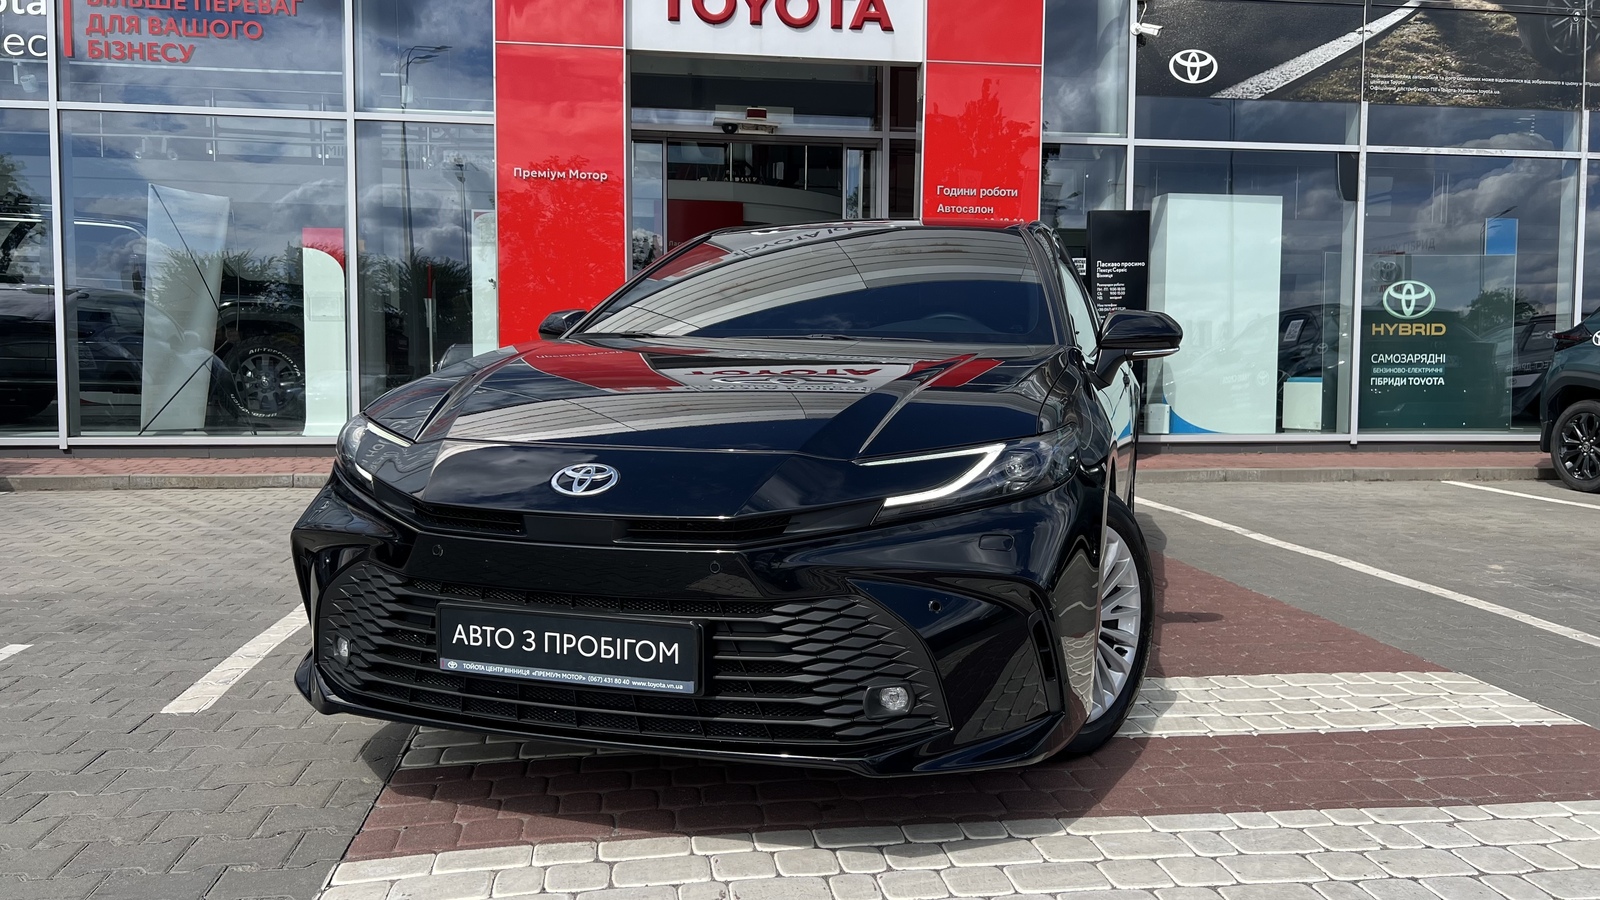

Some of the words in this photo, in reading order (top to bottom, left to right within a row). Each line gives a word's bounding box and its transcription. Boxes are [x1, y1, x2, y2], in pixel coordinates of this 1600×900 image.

[86, 13, 142, 36] ДЛЯ
[148, 16, 265, 40] ВАШОГО
[87, 39, 196, 63] БІЗНЕСУ
[513, 167, 566, 181] Преміум
[569, 169, 608, 182] Мотор
[936, 185, 977, 197] Години
[980, 186, 1018, 198] роботи
[936, 203, 994, 214] Автосалон
[1121, 260, 1145, 268] просимо
[1371, 323, 1447, 336] HYBRID
[1371, 353, 1446, 364] САМОЗАРЯДНІ
[1370, 377, 1406, 386] ГІБРИДИ
[1408, 377, 1445, 386] TOYOTA
[452, 623, 515, 650] АВТО
[521, 629, 536, 651] З
[544, 631, 679, 665] ПРОБІГОМ
[462, 662, 485, 671] ТОЙОТА
[485, 665, 504, 673] ЦЕНТР
[504, 667, 530, 676] ВІННИЦЯ
[561, 672, 586, 681] МОТОР»
[587, 674, 603, 684] (067)
[603, 676, 614, 684] 431
[614, 677, 622, 685] 80
[631, 679, 684, 690] www.toyota.vn.ua
